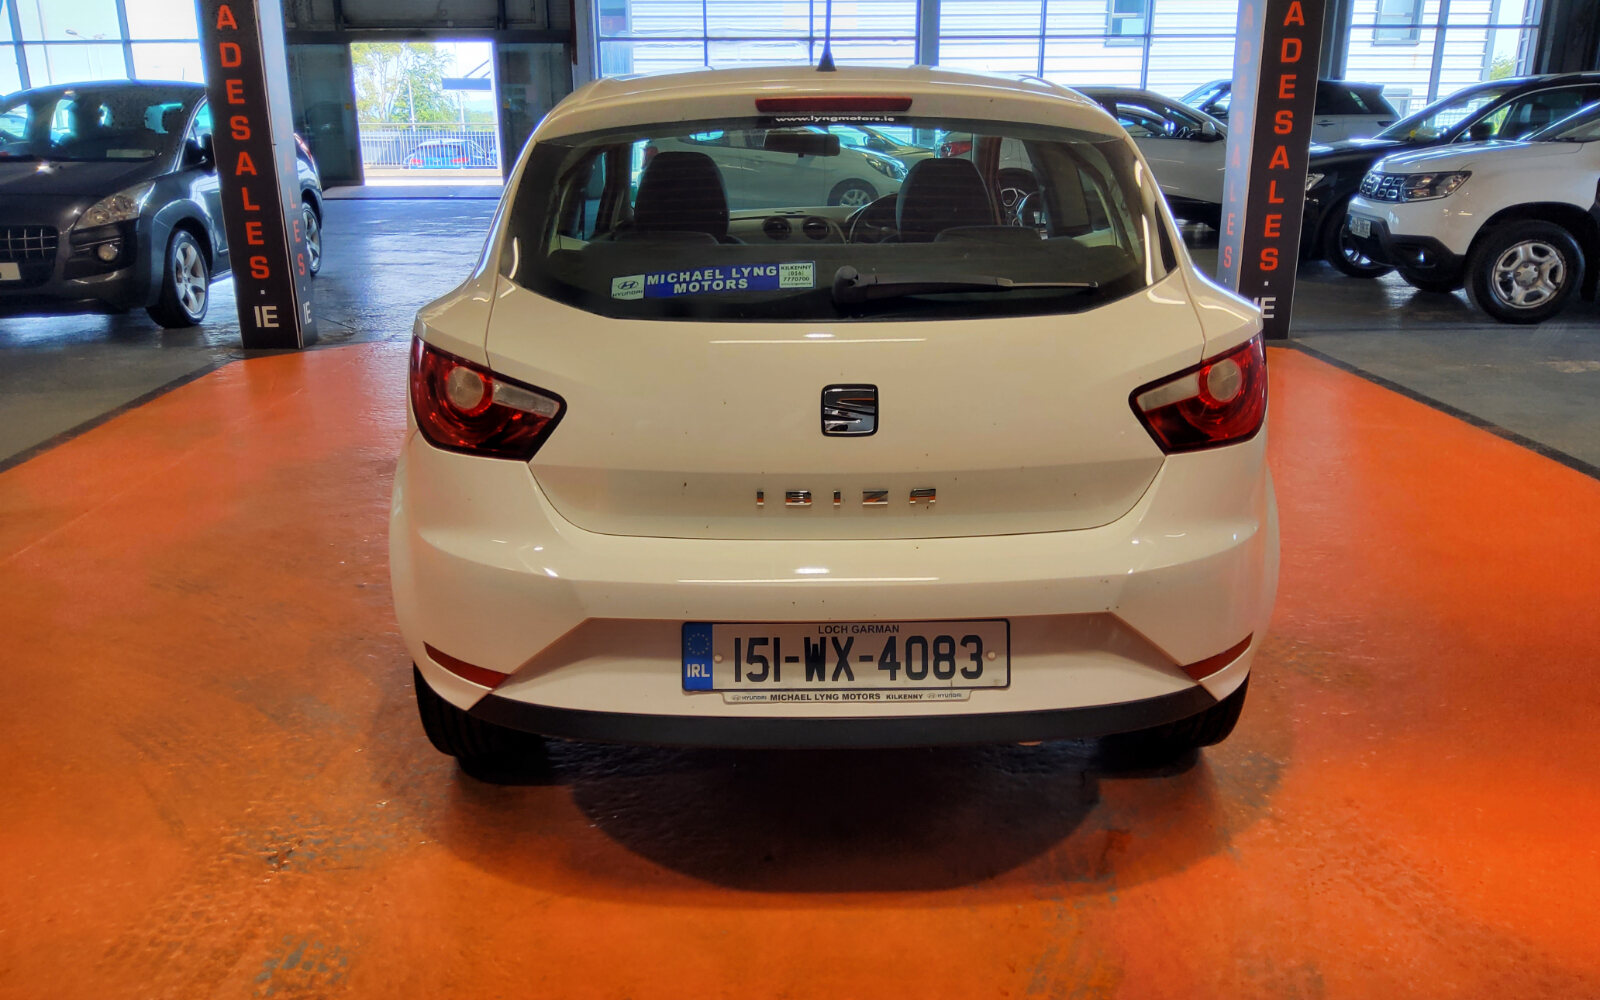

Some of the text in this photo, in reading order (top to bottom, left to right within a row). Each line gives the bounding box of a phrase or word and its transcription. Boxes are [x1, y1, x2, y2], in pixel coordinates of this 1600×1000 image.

[775, 115, 895, 123] www.lyngmotors.ie
[647, 265, 777, 285] MICHAEL LYNG
[673, 278, 749, 294] MOTORS
[756, 488, 937, 506] IBIZA
[818, 624, 900, 634] LOCH GARMAN
[734, 634, 984, 683] 151-WX-4083
[686, 663, 711, 678] IRL
[770, 693, 810, 701] MICHAEL
[814, 693, 839, 701] LYNG
[841, 692, 881, 700] MOTORS
